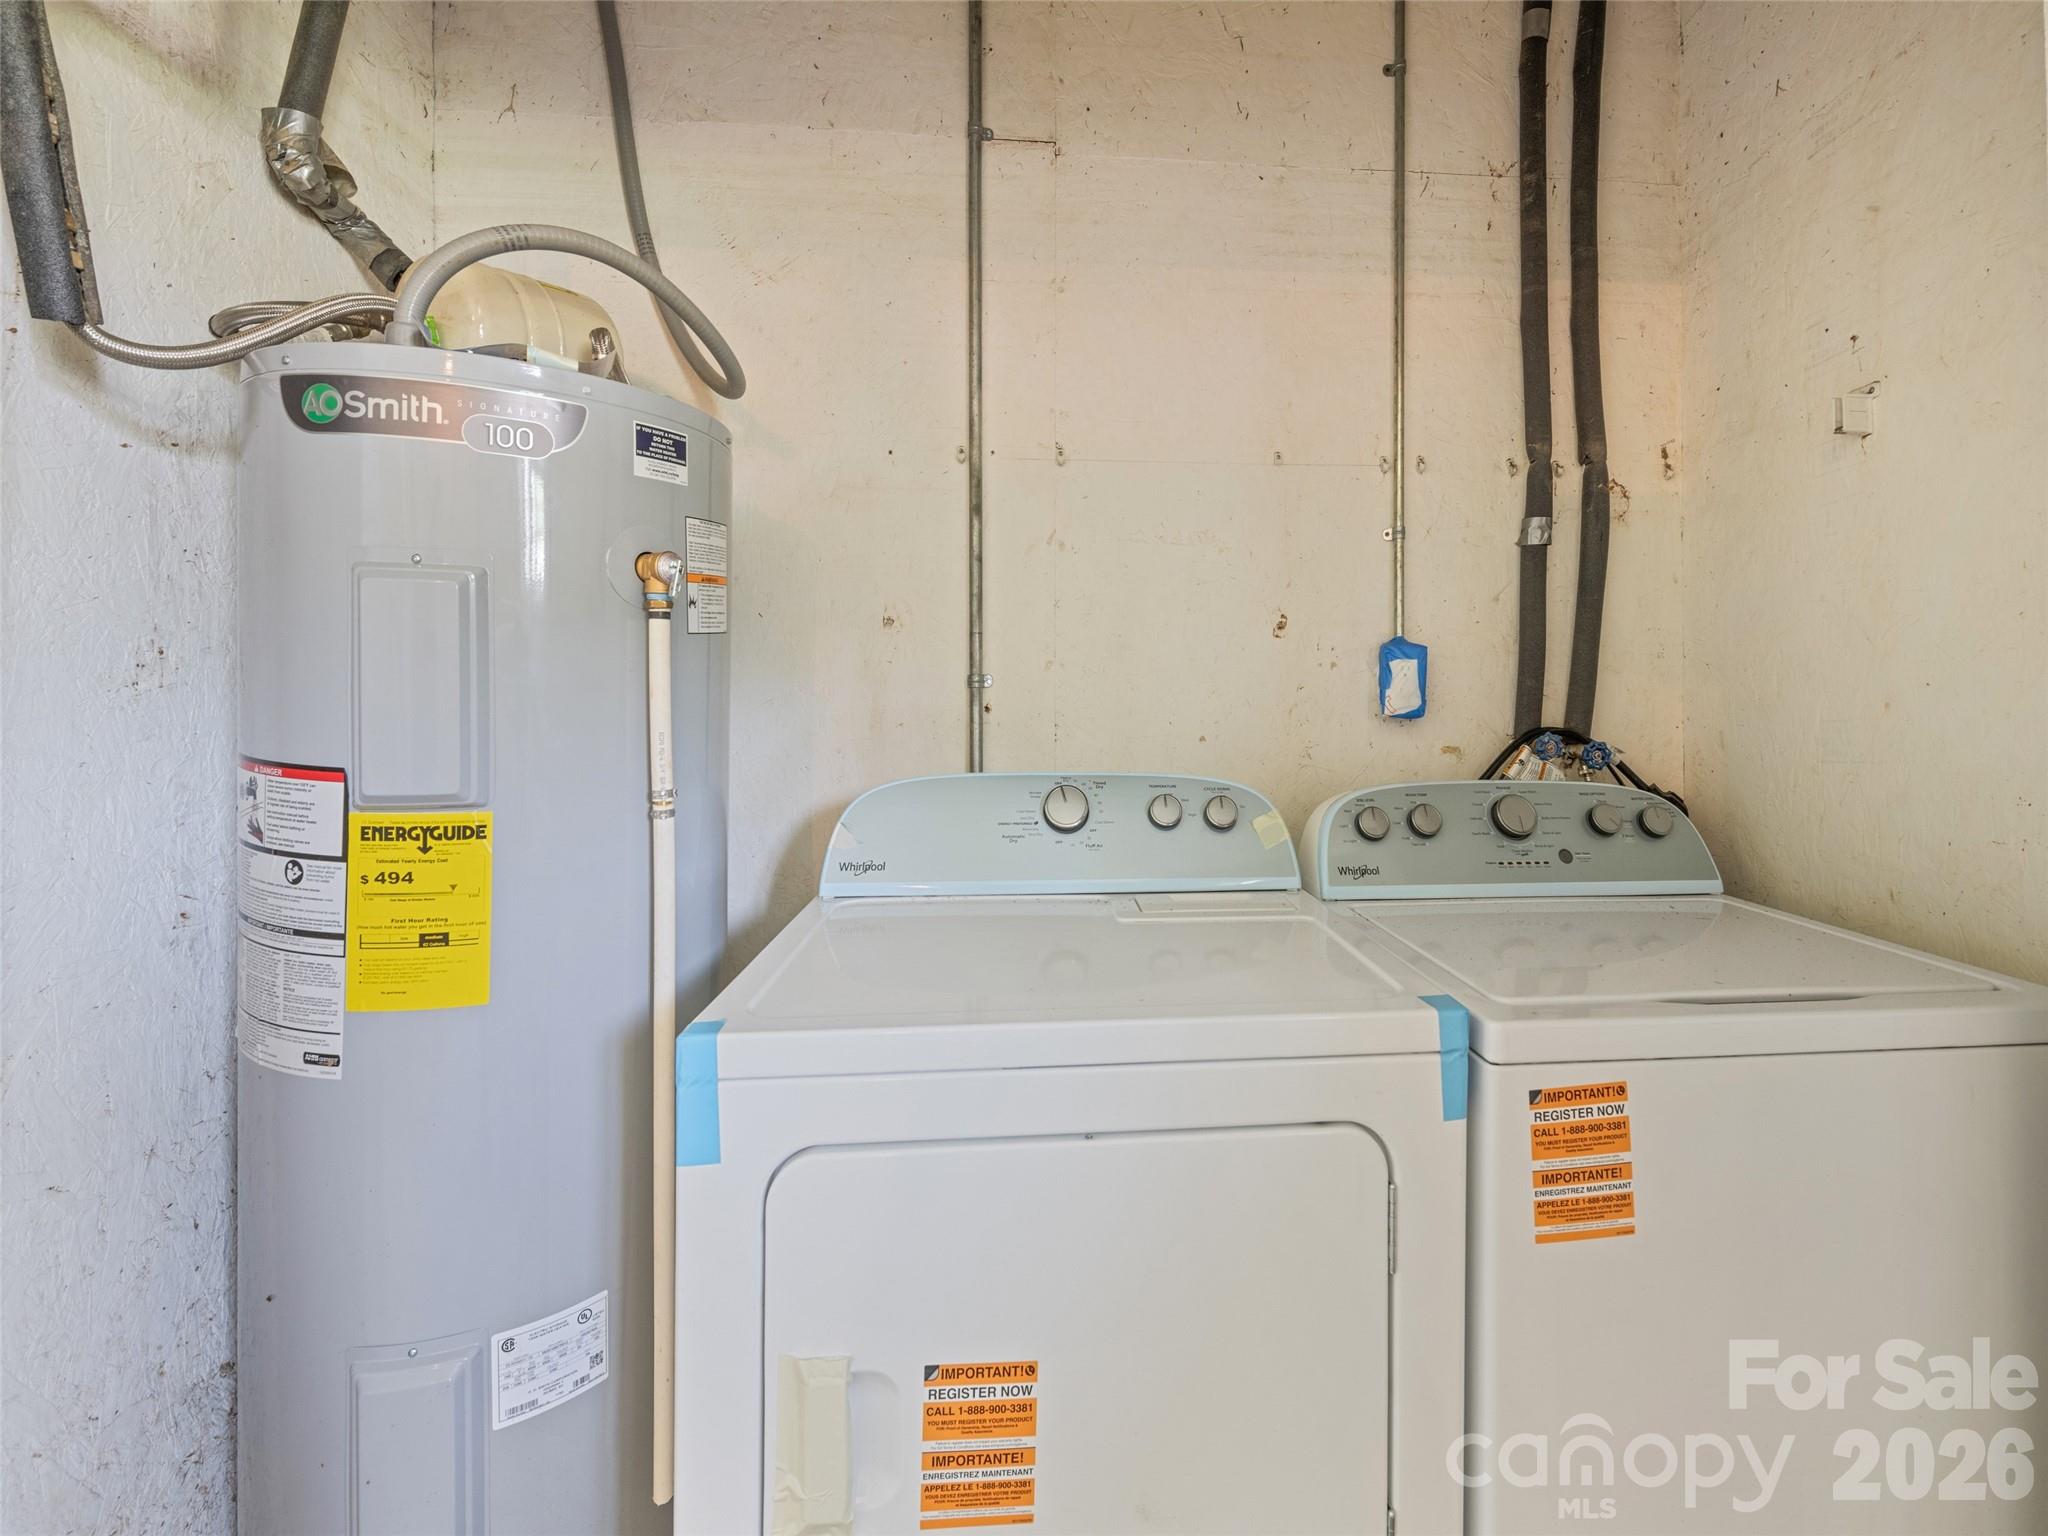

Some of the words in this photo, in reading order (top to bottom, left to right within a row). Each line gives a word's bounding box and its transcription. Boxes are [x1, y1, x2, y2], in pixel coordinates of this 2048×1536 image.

[456, 399, 561, 423] SIGNATURE
[485, 422, 534, 451] 100
[260, 767, 282, 776] DANGER
[360, 825, 487, 842] ENERGYGUIDE
[838, 860, 886, 876] Whirlpool
[1337, 865, 1380, 880] Whirlpool
[360, 874, 369, 884] $
[374, 871, 414, 884] 494
[1544, 1086, 1616, 1103] IMPORTANT!
[1534, 1107, 1594, 1122] REGISTER
[1597, 1104, 1625, 1116] NOW
[1534, 1128, 1559, 1138] CALL
[1562, 1121, 1626, 1135] 1-888-900-3381
[1541, 1168, 1622, 1185] IMPORTANTE!
[1534, 1187, 1585, 1197] ENREGISTREZ
[1586, 1182, 1632, 1193] MAINTENANT
[1537, 1200, 1569, 1209] APPELEZ
[941, 1366, 1024, 1380] IMPORTANT!
[928, 1386, 996, 1400] REGISTER
[1001, 1385, 1033, 1397] NOW
[926, 1407, 955, 1416] CALL
[958, 1403, 1033, 1415] 1-888-900-3381
[931, 1452, 1024, 1468] IMPORTANTE!
[922, 1471, 979, 1481] ENREGISTREZ
[981, 1468, 1034, 1478] MAINTENANT
[924, 1484, 961, 1493] APPELEZ
[976, 1481, 1031, 1489] 1-888-900-3381
